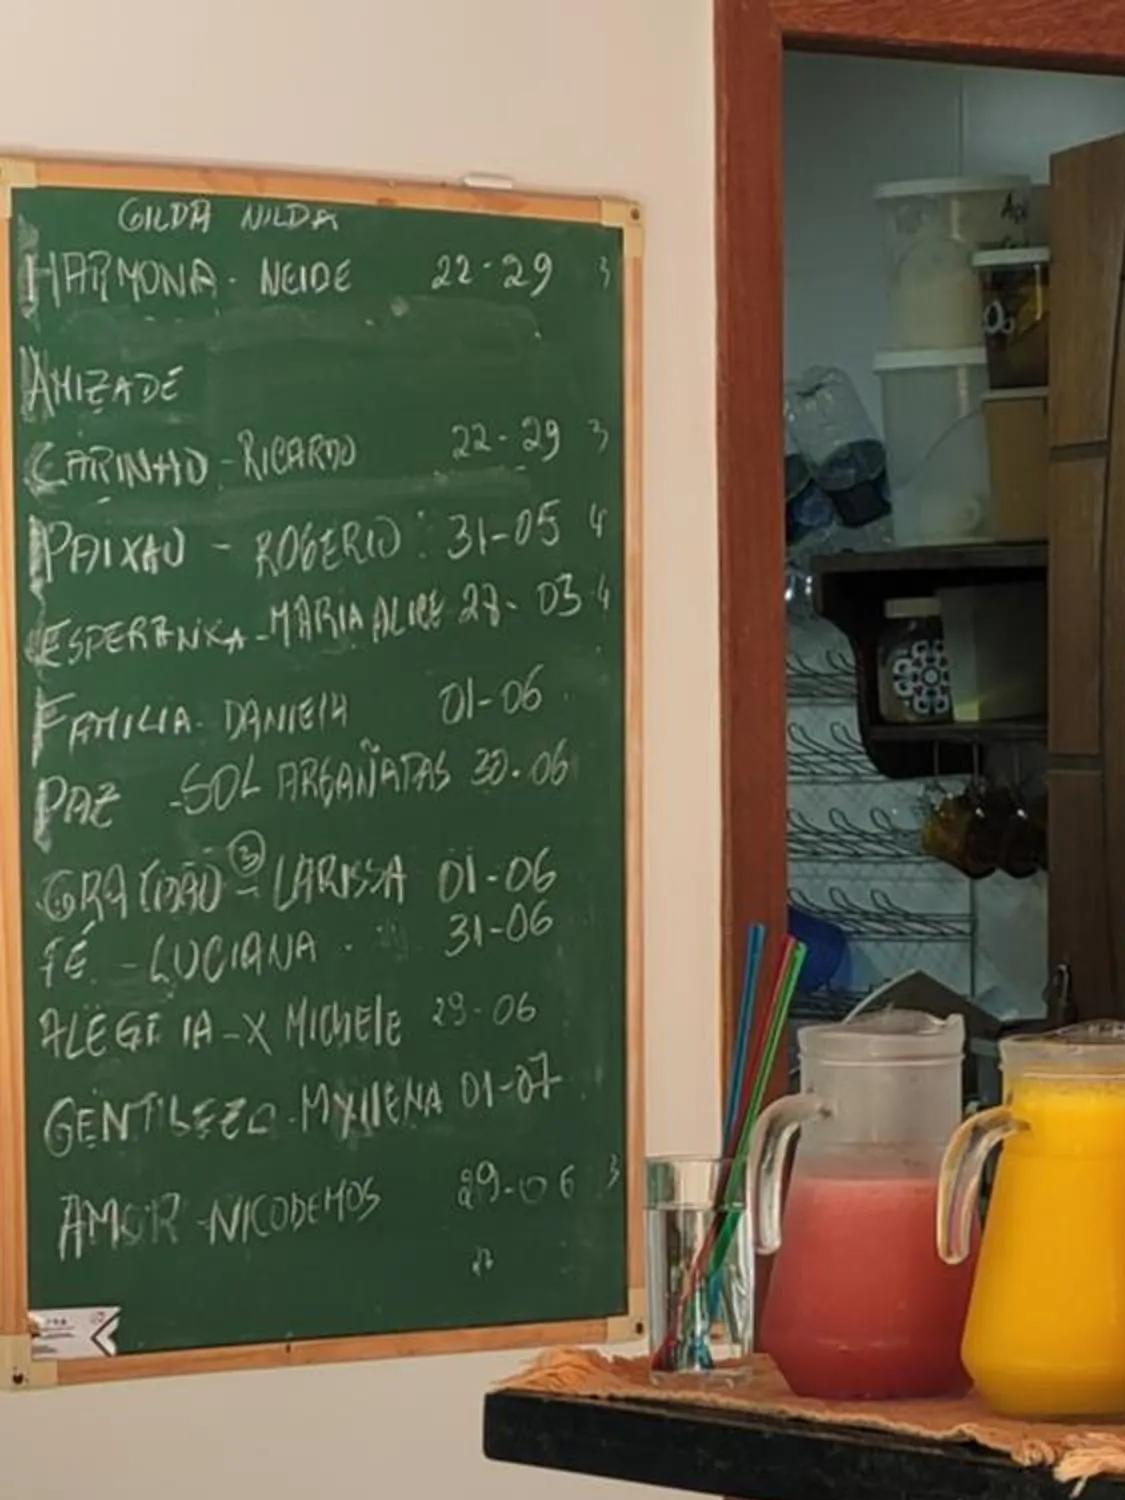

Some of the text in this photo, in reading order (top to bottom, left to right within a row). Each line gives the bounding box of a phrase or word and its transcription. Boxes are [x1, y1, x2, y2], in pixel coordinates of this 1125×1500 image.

[118, 197, 339, 234] GILDA NILDA
[260, 257, 352, 297] NEIDE
[273, 853, 407, 912] LARISSA
[149, 931, 318, 984] LUCIANA
